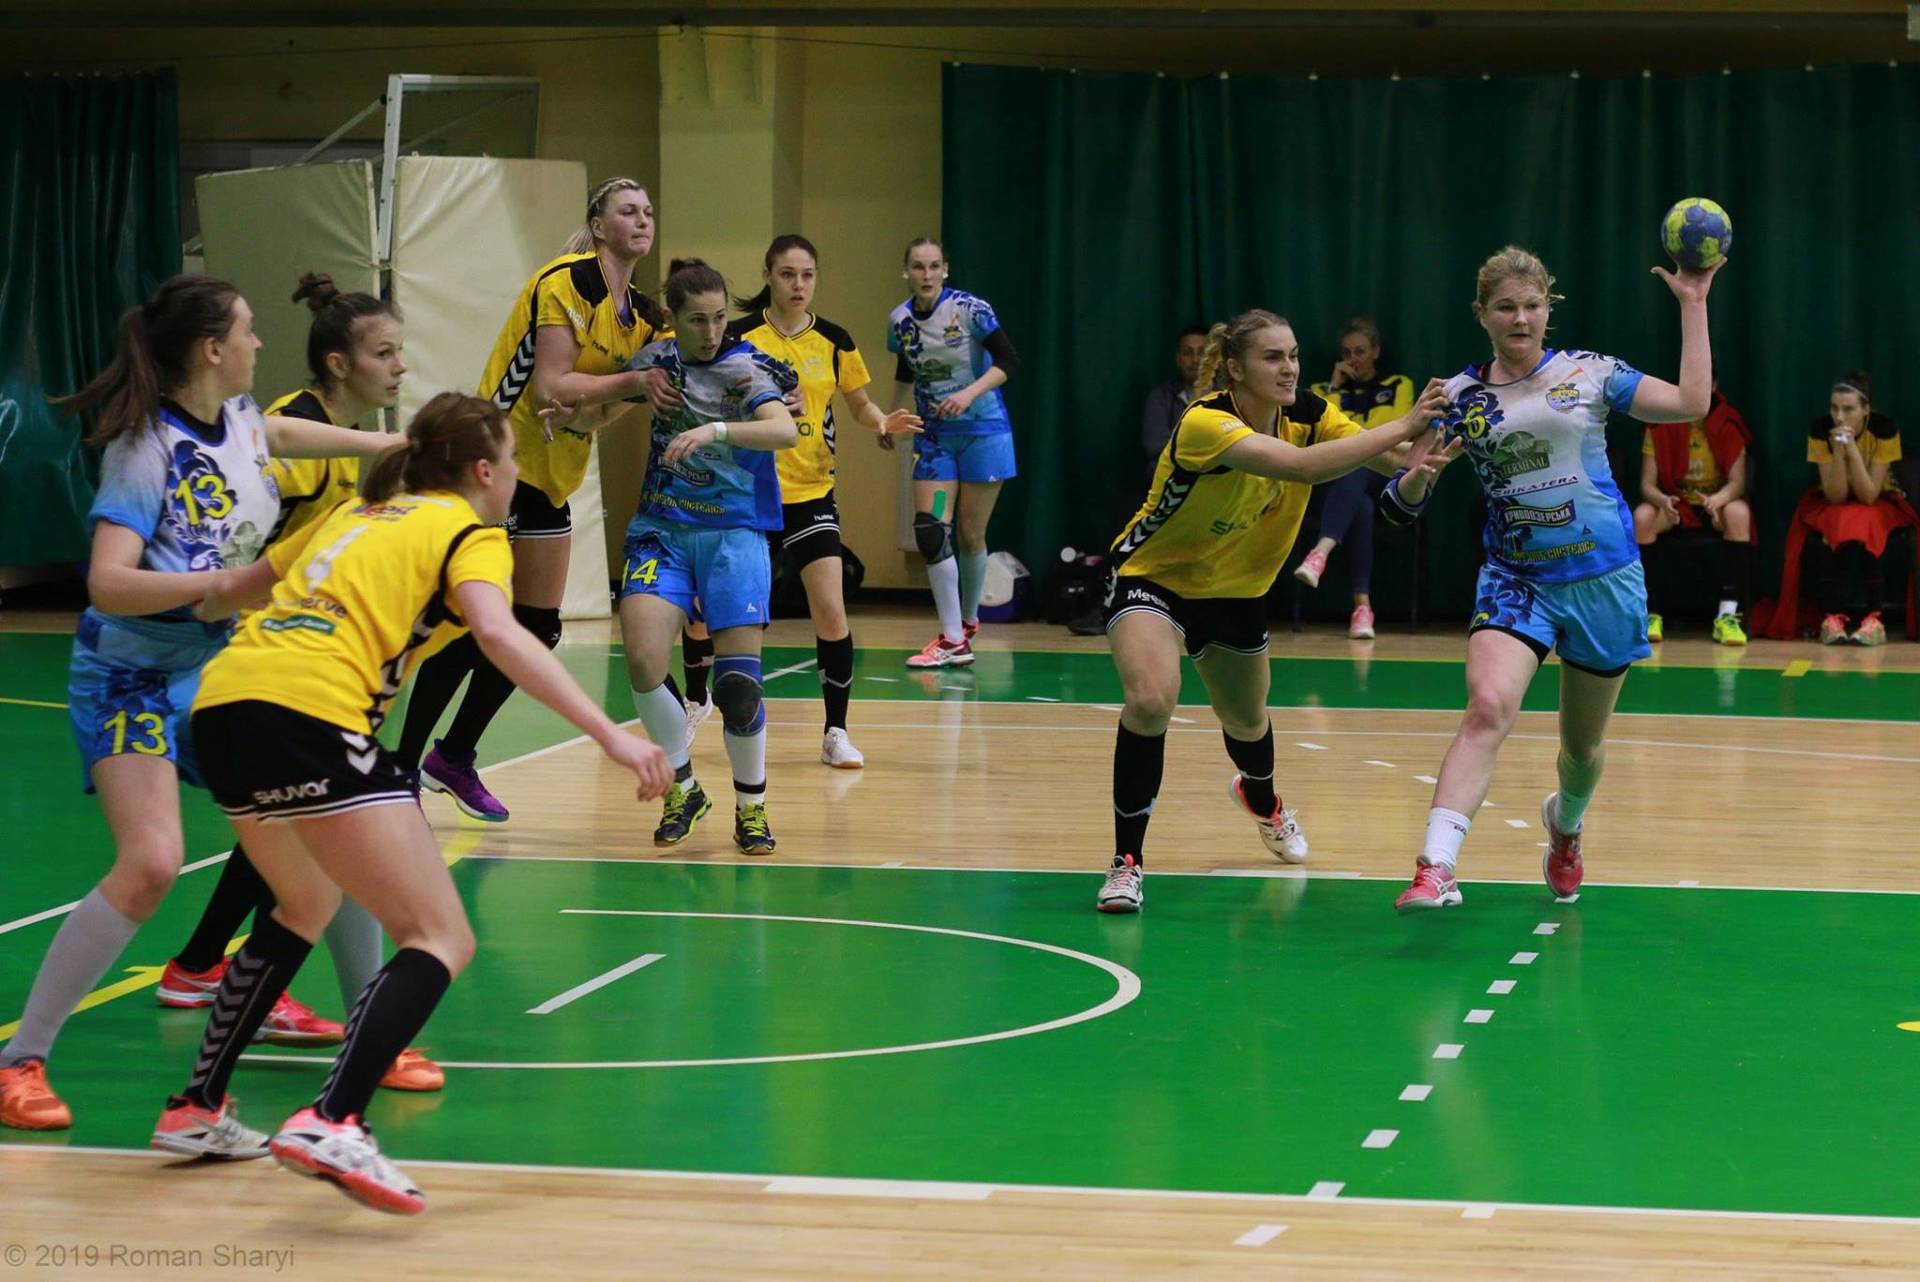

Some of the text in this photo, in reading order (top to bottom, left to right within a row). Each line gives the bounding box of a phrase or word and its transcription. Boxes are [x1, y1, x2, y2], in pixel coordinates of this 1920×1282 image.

[1464, 405, 1486, 439] 6
[1503, 456, 1547, 475] TERMINAL
[175, 474, 233, 526] 13
[622, 558, 660, 591] 14
[103, 710, 167, 756] 13
